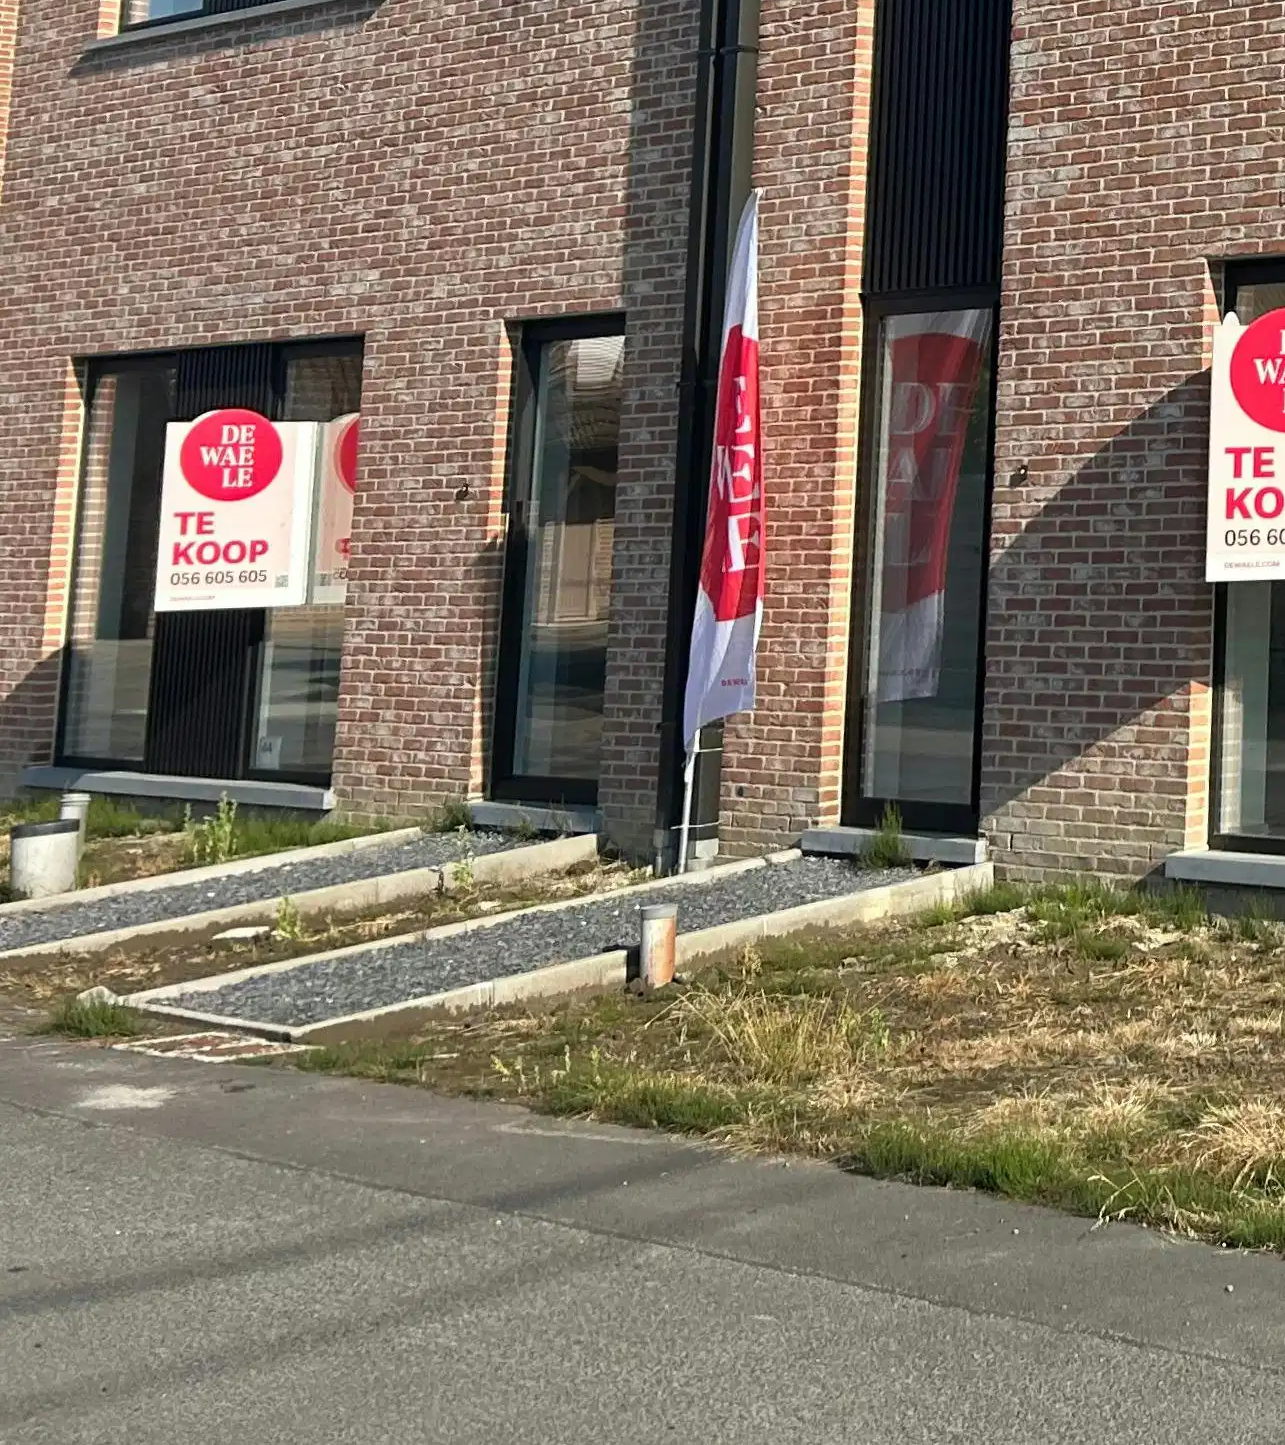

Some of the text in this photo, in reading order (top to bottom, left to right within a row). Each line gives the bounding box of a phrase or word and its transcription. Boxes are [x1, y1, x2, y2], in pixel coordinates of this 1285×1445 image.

[221, 424, 256, 445] DE
[200, 445, 255, 466] WAE
[1224, 446, 1275, 478] TE
[222, 467, 254, 488] LE
[173, 511, 215, 536] TE
[1224, 528, 1261, 547] 056
[172, 539, 269, 566] KOOP
[170, 570, 267, 586] 056 605 605
